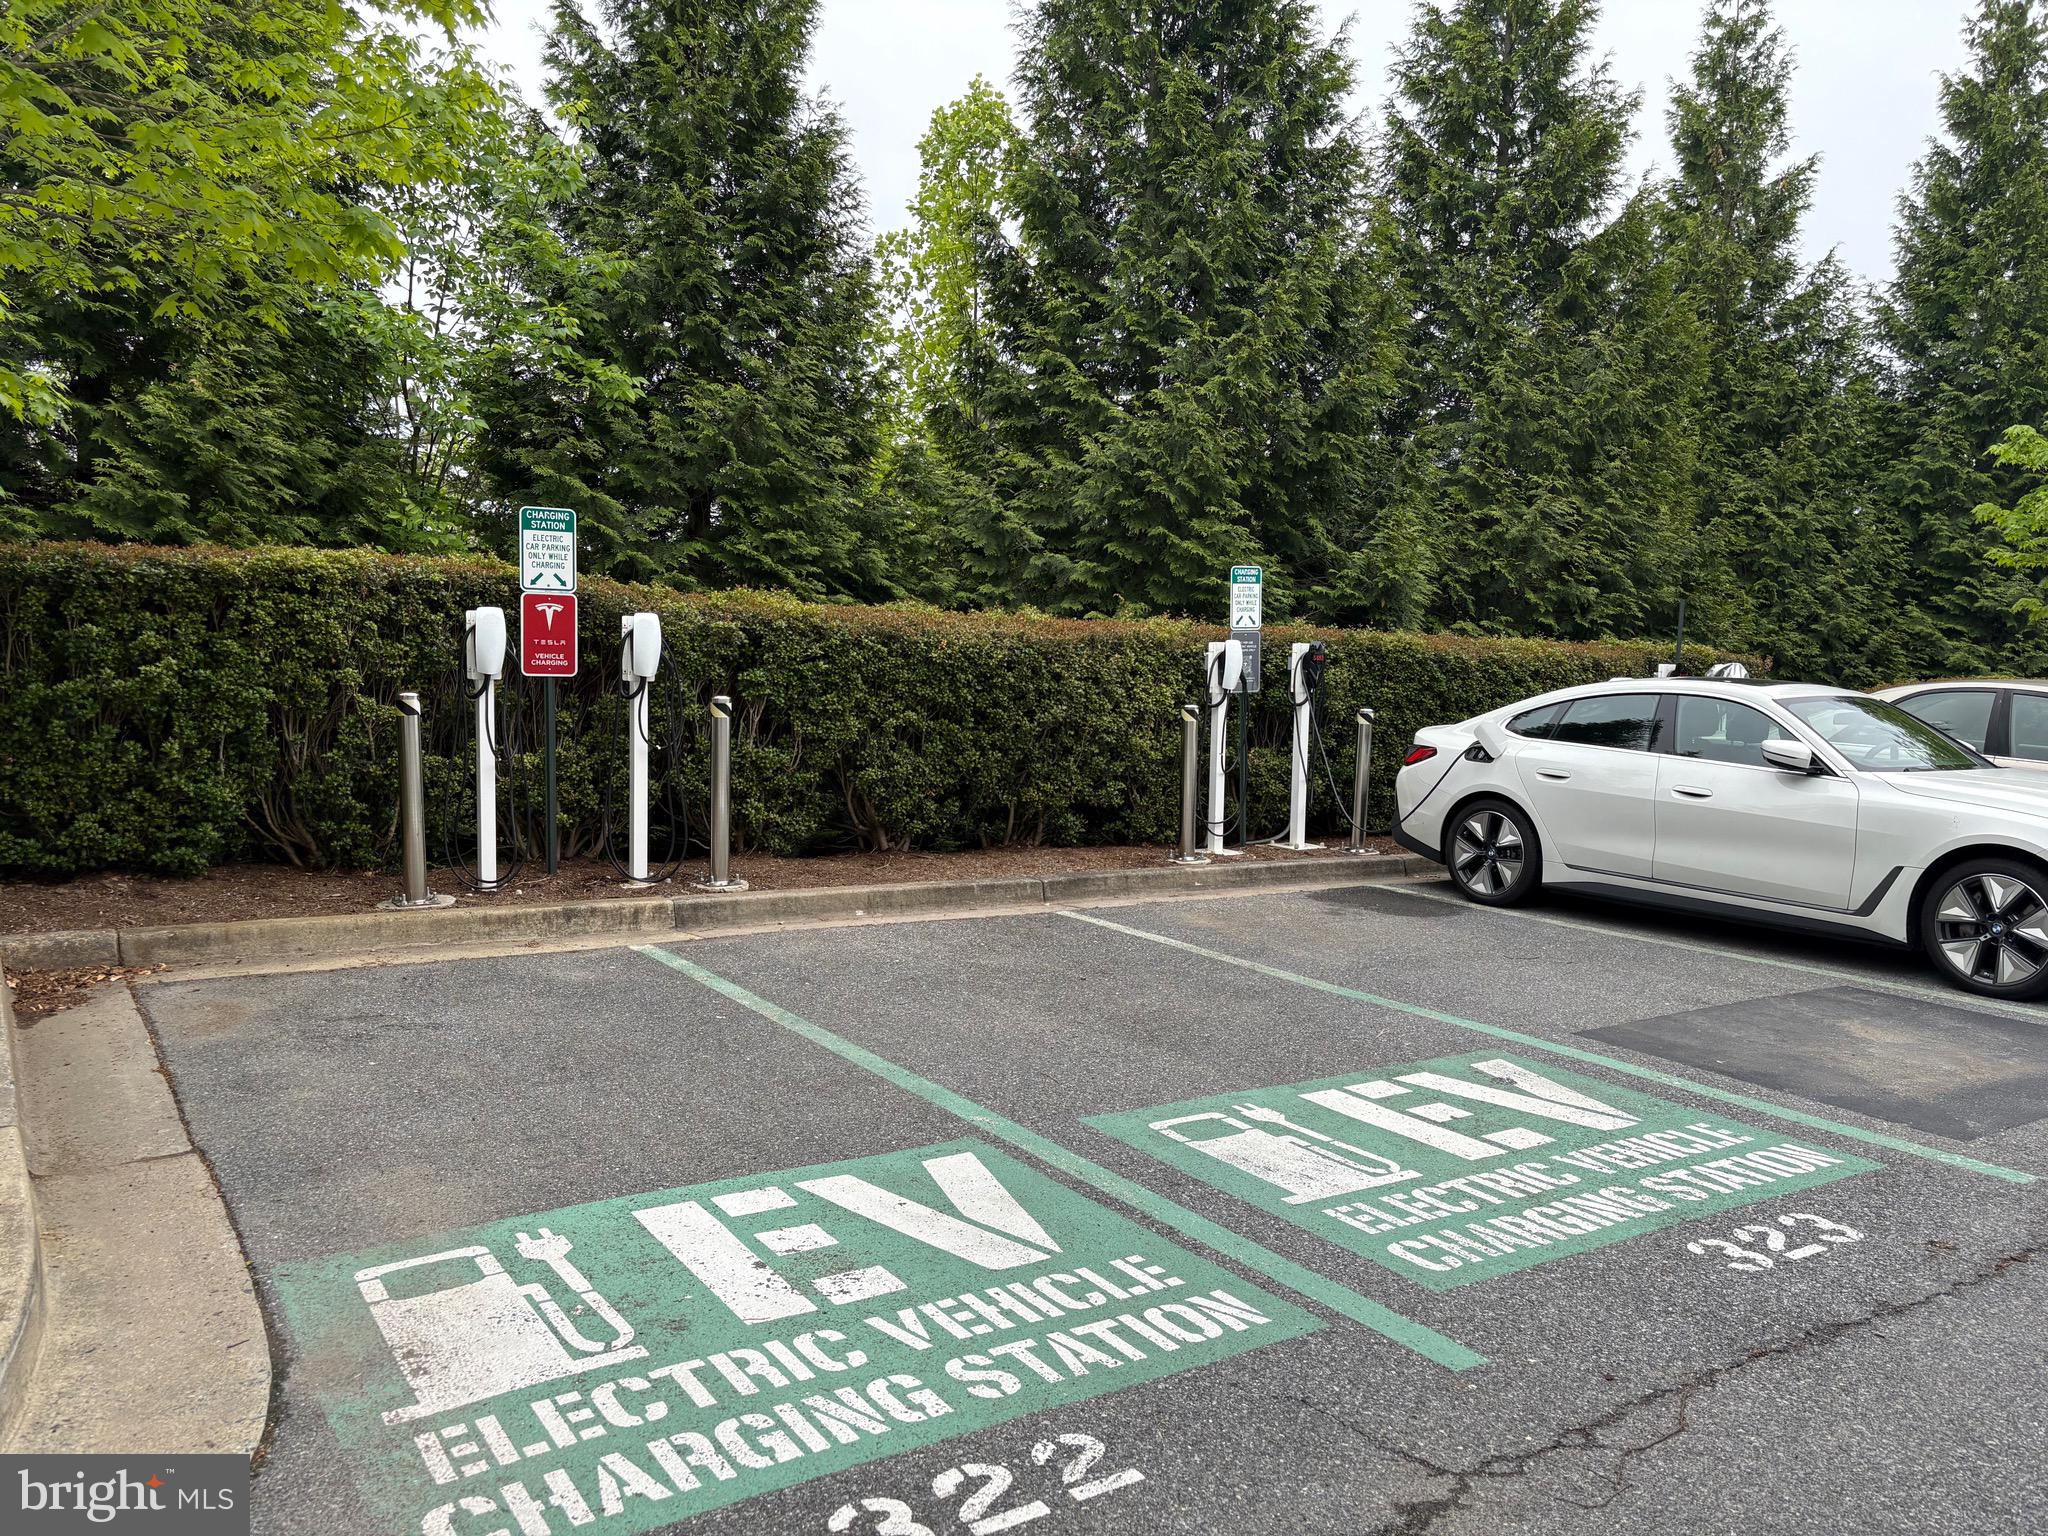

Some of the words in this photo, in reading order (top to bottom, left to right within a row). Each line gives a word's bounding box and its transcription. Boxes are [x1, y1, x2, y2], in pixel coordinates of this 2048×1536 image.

[526, 510, 570, 520] CHARGING
[531, 520, 566, 530] STATION
[532, 534, 564, 543] ELECTRIC
[526, 542, 540, 551] CAR
[541, 543, 571, 552] PARKING
[528, 551, 546, 560] ONLY
[549, 552, 568, 561] WHILE
[531, 560, 565, 570] CHARGING
[1234, 568, 1259, 576] CHARGING
[535, 652, 565, 660] VEHICLE
[531, 659, 568, 667] CHARGING
[1298, 1059, 1642, 1160] EV
[1322, 1162, 1581, 1235] ELECTRIC
[1550, 1123, 1754, 1174] VEHICLE
[1387, 1186, 1675, 1271] CHARGING
[1639, 1143, 1845, 1201] STATION
[631, 1151, 1063, 1325] EV
[1687, 1212, 1865, 1271] 323
[413, 1330, 869, 1485] ELECTRIC
[863, 1254, 1186, 1350] VEHICLE
[421, 1374, 953, 1536] CHARGING
[945, 1289, 1272, 1398] STATION
